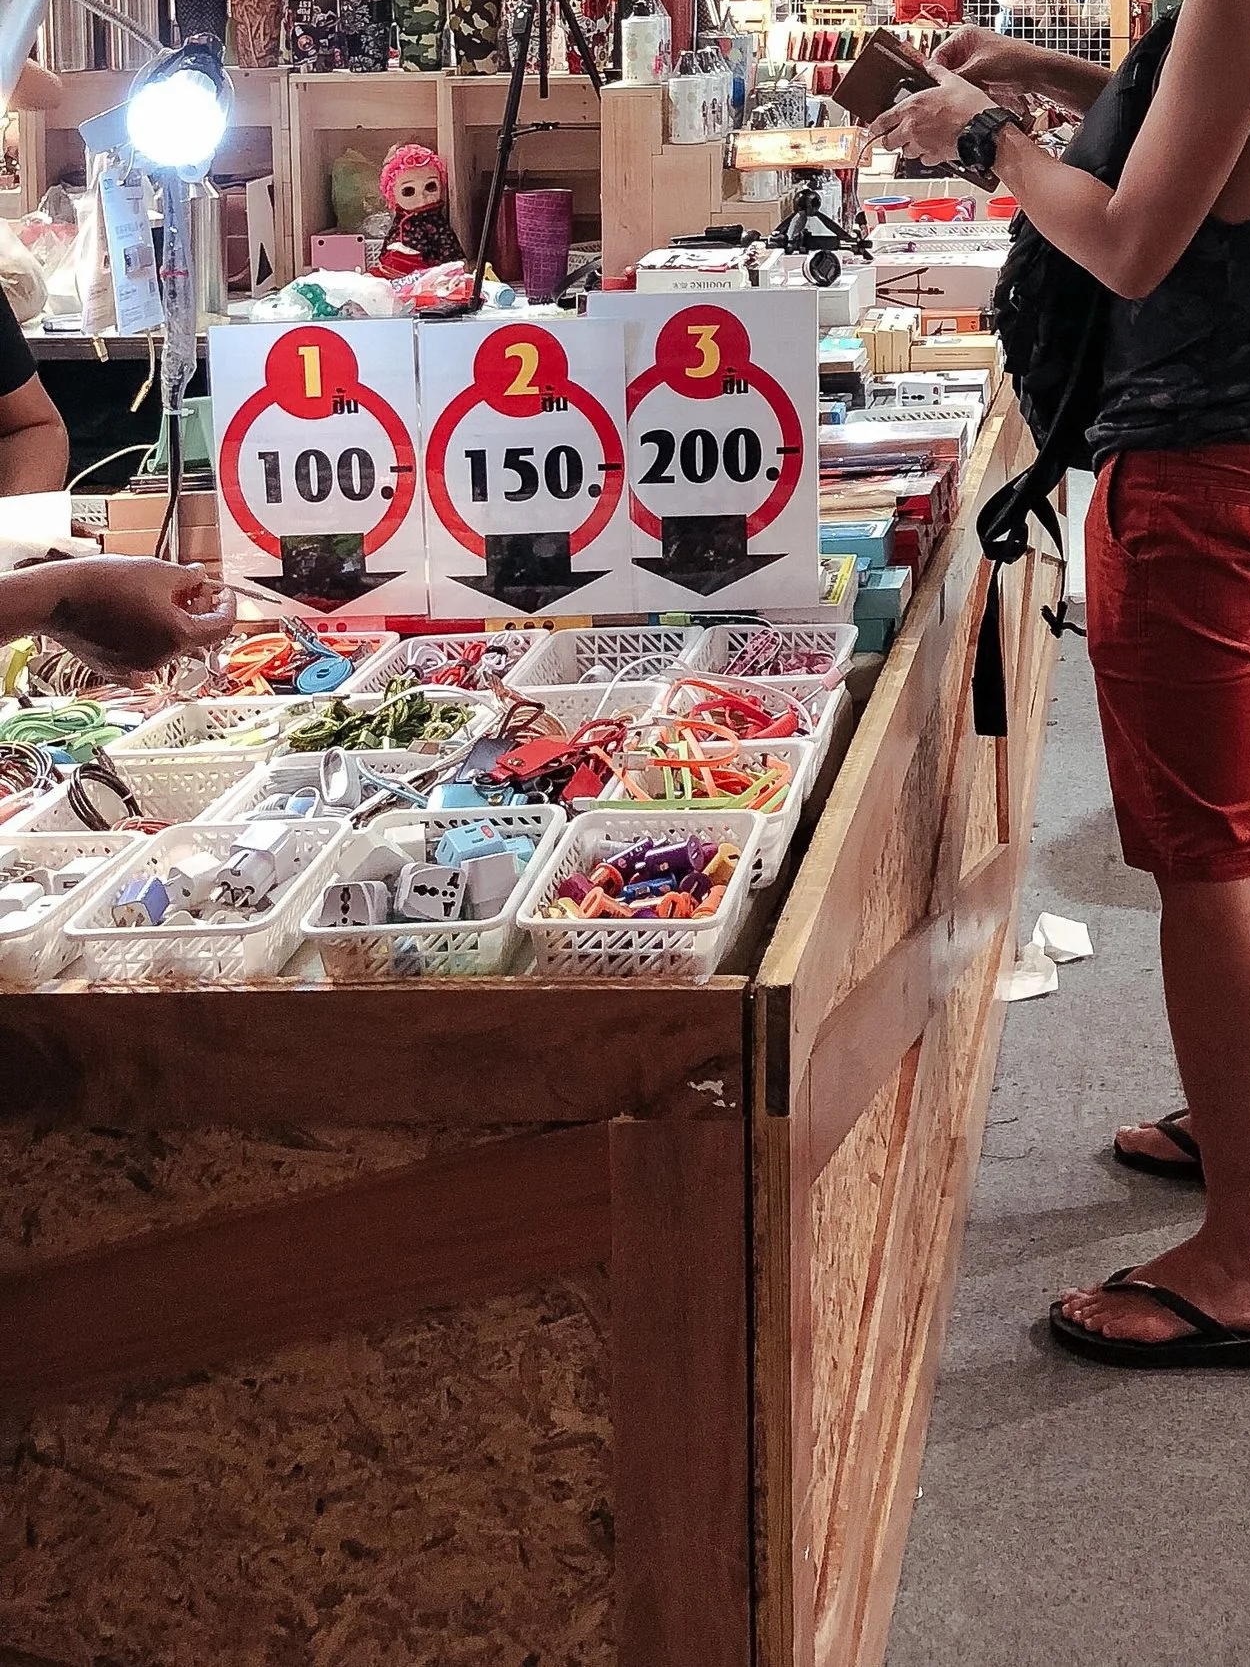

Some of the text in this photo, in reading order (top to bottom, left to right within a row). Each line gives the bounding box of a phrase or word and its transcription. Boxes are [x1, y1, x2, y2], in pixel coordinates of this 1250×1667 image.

[298, 346, 322, 398] 1
[503, 343, 540, 396] 2
[685, 324, 721, 378] 3
[258, 447, 413, 504] 100.-
[464, 445, 621, 502] 150.-
[637, 428, 801, 484] 200.-
